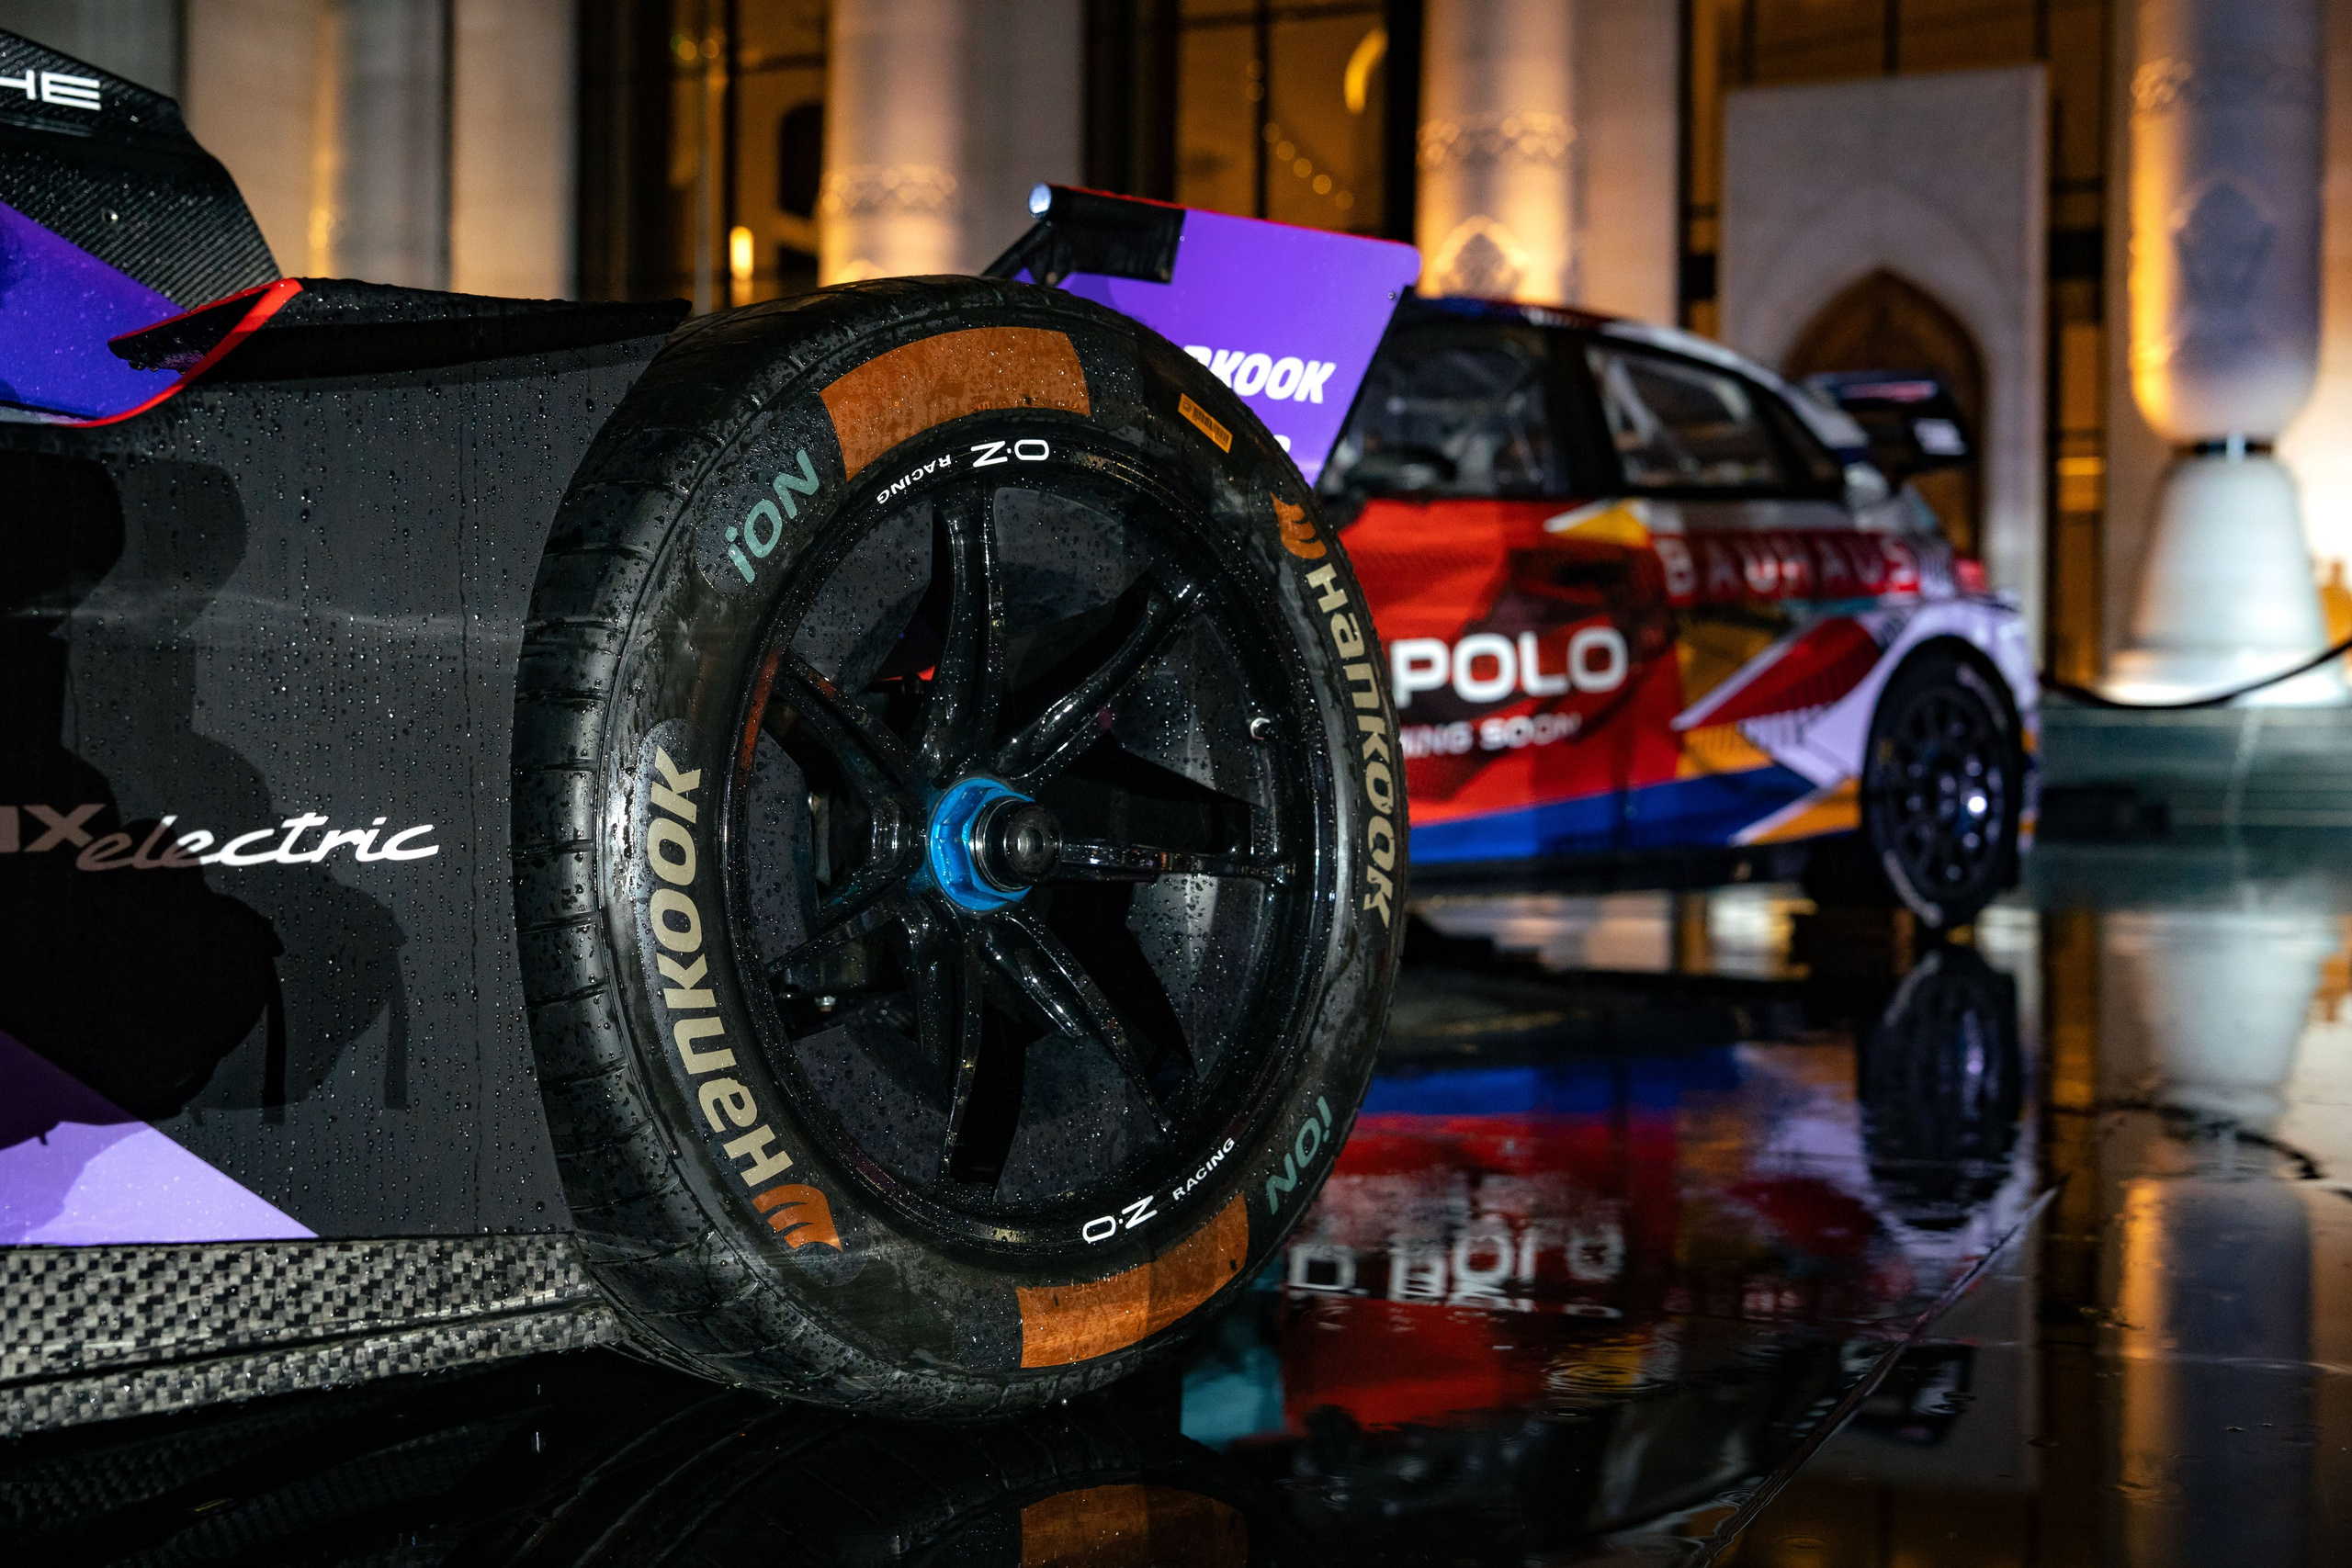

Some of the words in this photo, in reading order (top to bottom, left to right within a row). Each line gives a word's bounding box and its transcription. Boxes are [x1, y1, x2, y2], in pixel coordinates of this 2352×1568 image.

[1183, 344, 1337, 404] KOOK
[876, 454, 952, 504] RACING
[1389, 625, 1629, 710] POLO
[1172, 1137, 1236, 1201] RACING
